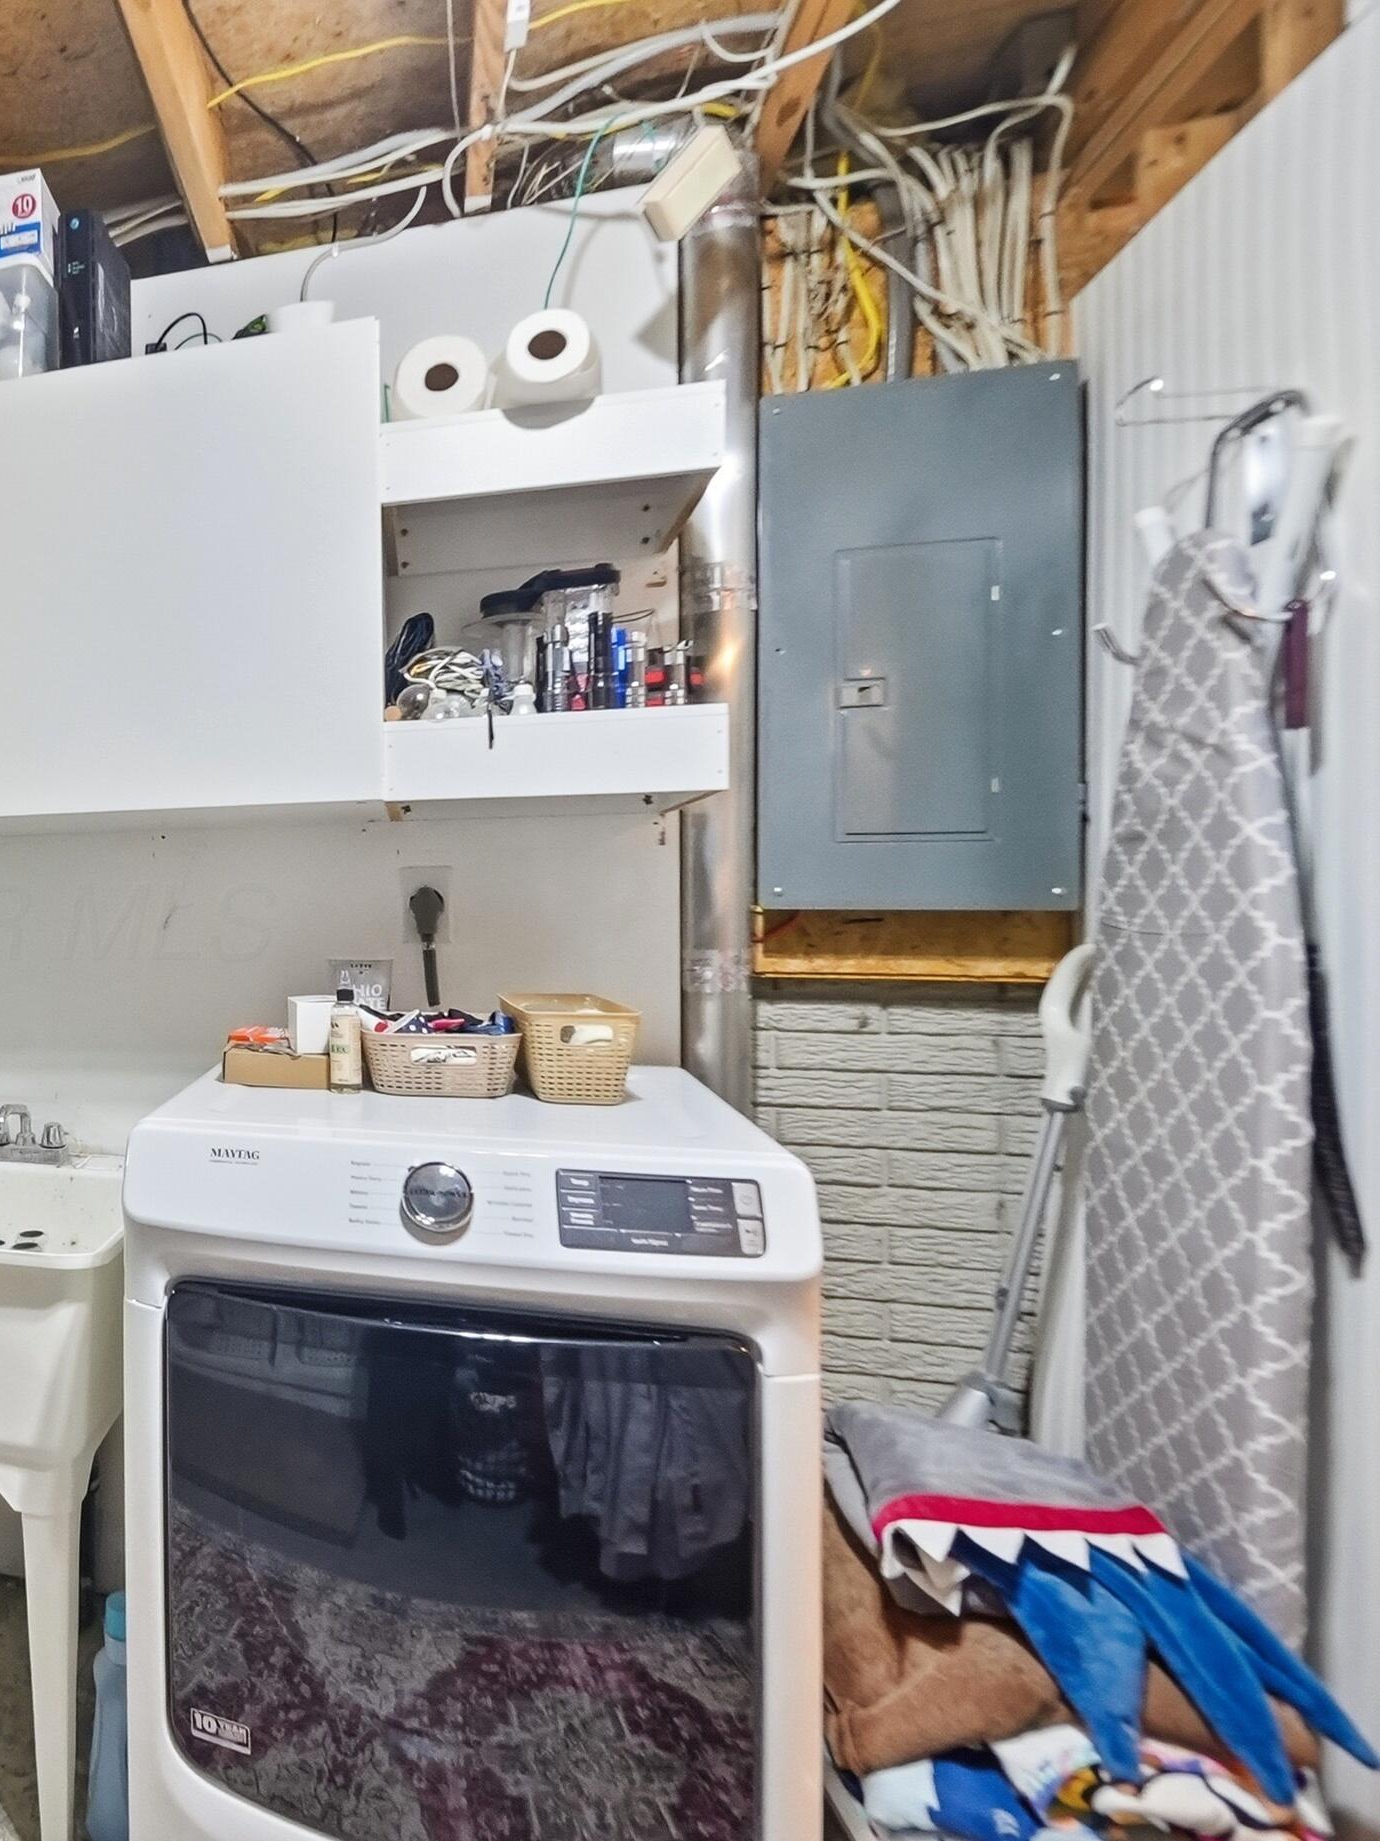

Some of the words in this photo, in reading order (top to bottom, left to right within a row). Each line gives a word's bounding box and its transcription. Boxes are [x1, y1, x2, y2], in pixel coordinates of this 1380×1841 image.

[14, 195, 35, 218] 10
[210, 1147, 260, 1160] MAYTAG
[193, 1711, 218, 1735] 10
